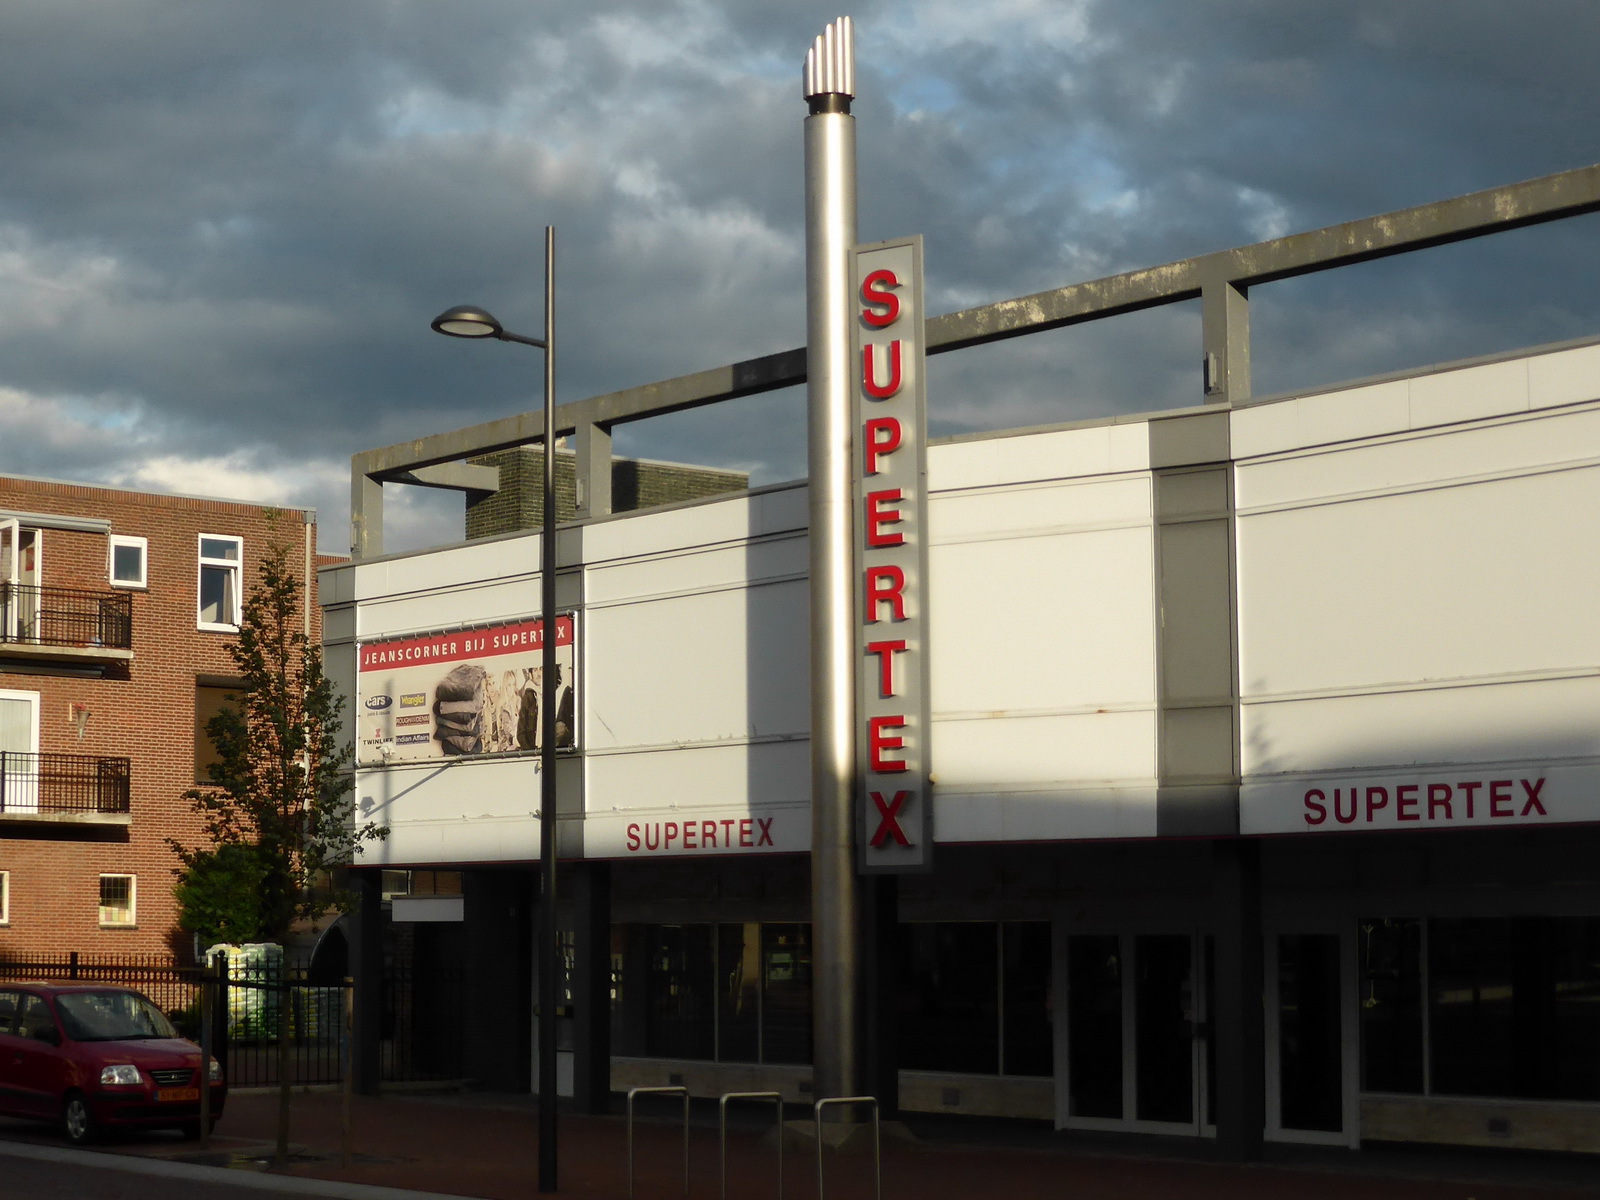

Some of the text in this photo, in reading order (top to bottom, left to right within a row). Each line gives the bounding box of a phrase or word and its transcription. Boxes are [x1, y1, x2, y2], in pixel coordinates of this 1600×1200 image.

[860, 269, 909, 848] SUPERTEX
[365, 626, 565, 665] JEANSCORNER BIJ SUPERTX
[1304, 777, 1548, 825] SUPERTEX
[626, 817, 774, 851] SUPERTEX
